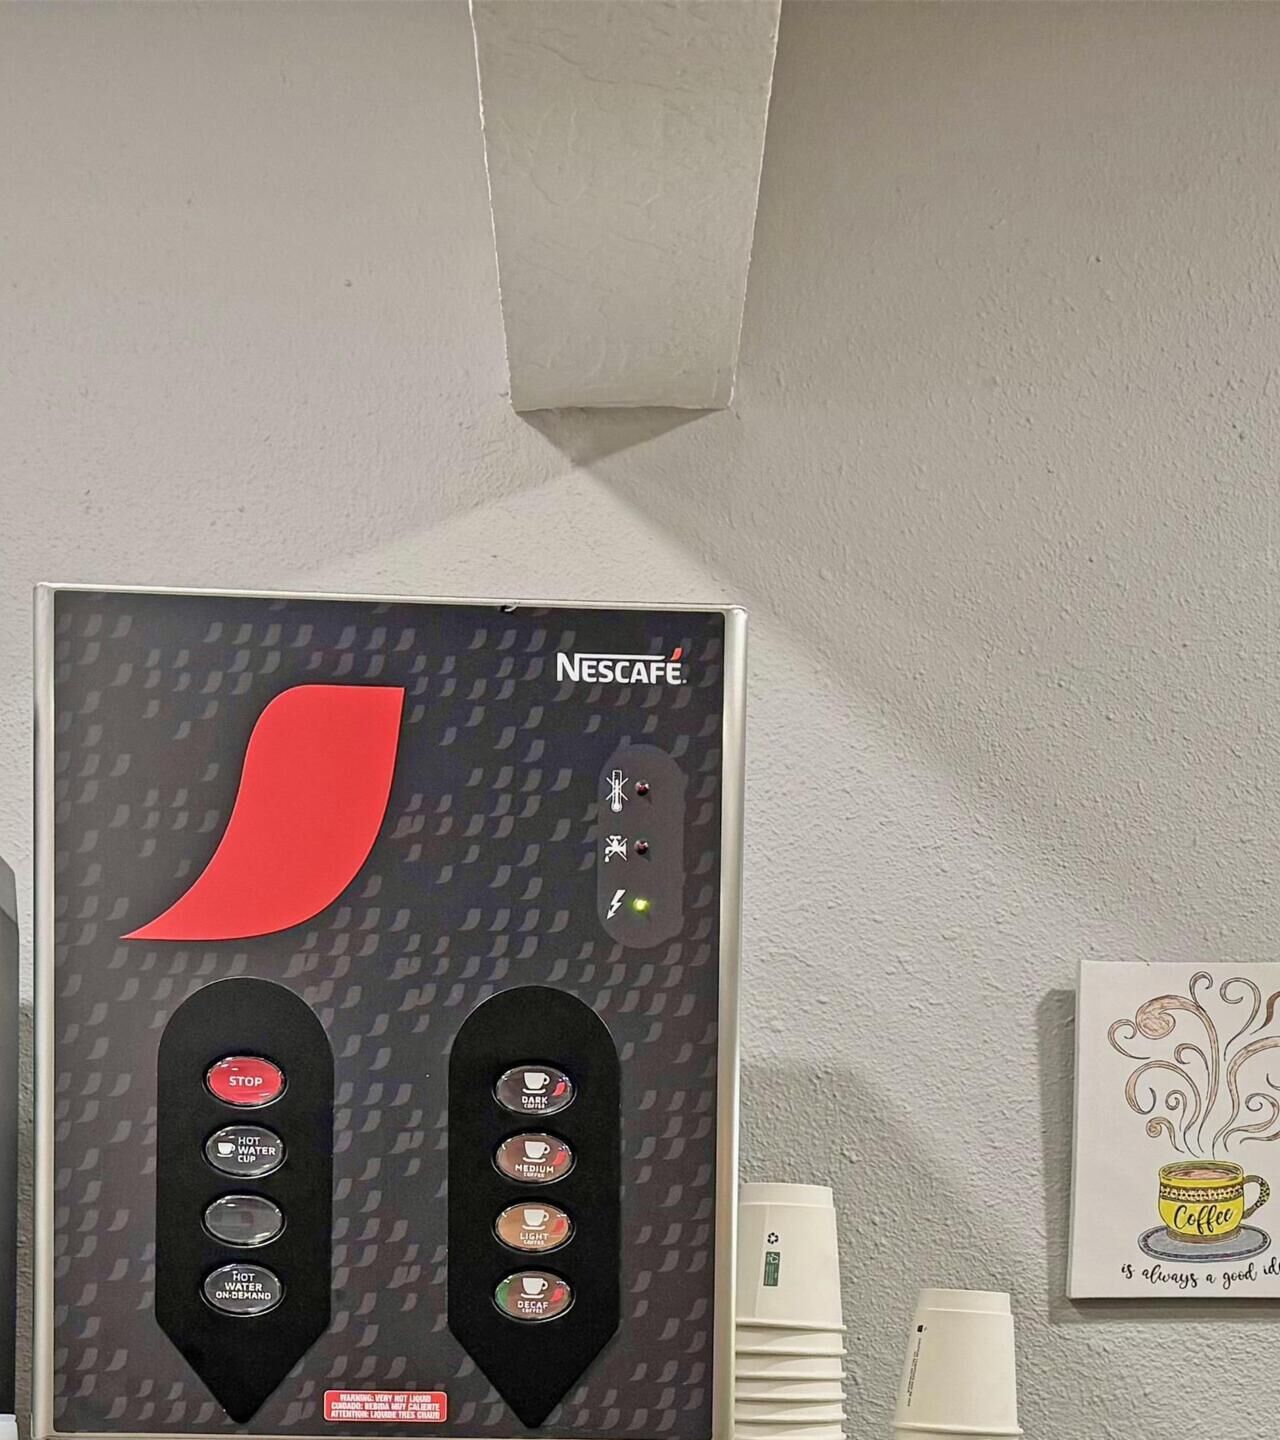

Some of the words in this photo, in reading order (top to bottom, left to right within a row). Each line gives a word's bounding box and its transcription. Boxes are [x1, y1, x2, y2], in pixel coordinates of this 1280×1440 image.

[556, 646, 687, 685] NESCAFÉ
[229, 1076, 263, 1087] STOP
[521, 1096, 548, 1104] DARK
[238, 1136, 260, 1145] HOT
[238, 1146, 275, 1155] WATER
[238, 1155, 256, 1163] CUP
[515, 1165, 554, 1173] MEDIUM
[1174, 1204, 1234, 1235] Coffee
[520, 1232, 549, 1240] LIGHT
[233, 1273, 255, 1282] HOT
[1121, 1263, 1136, 1279] is
[1142, 1264, 1199, 1290] always
[1206, 1272, 1216, 1284] a
[1223, 1262, 1258, 1290] good
[225, 1282, 262, 1291] WATER
[216, 1291, 271, 1300] ON-DEMAND
[517, 1301, 548, 1309] DECAF
